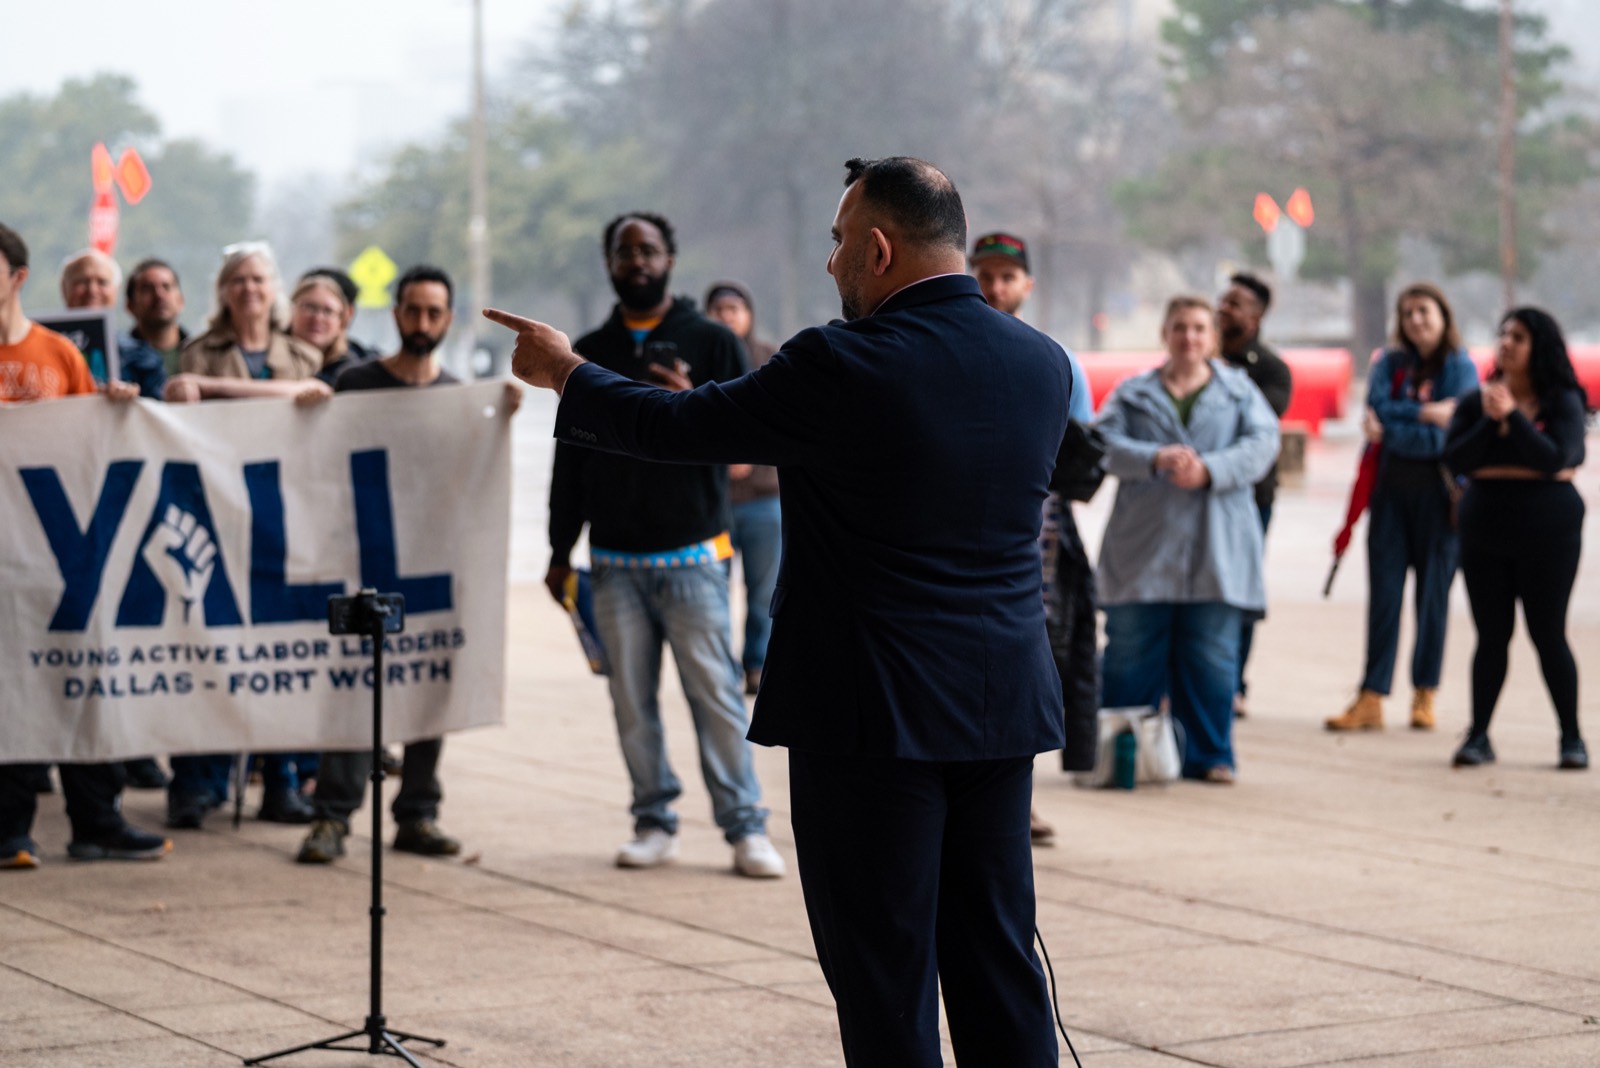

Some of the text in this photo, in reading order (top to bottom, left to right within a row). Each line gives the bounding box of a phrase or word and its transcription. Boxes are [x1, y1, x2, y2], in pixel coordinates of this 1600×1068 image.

[0, 360, 60, 400] XAS
[18, 448, 454, 633] YALL
[30, 628, 466, 668] YOUNG ACTIVE LABOR LEADERS
[64, 672, 194, 699] DALLAS
[229, 668, 316, 695] FORT
[327, 659, 452, 689] WORTH
